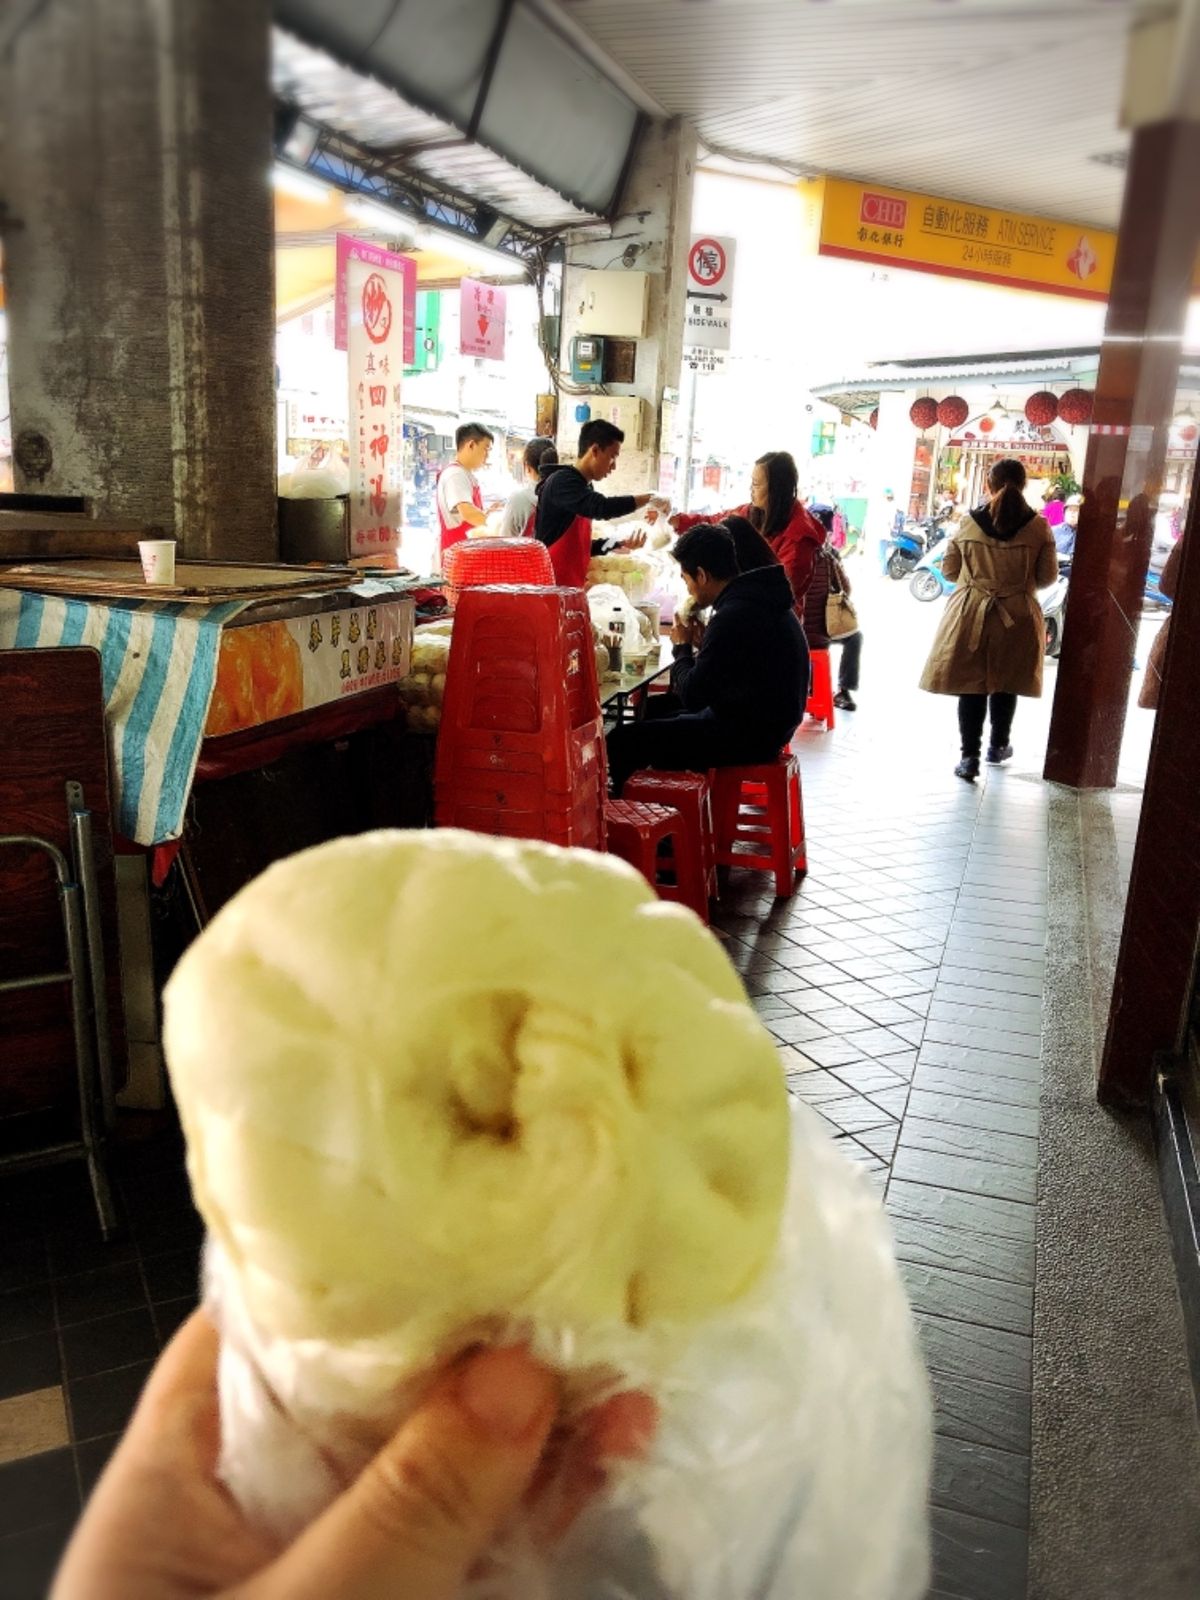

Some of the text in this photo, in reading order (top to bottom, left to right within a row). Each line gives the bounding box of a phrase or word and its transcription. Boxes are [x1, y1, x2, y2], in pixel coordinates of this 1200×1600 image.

[863, 197, 905, 227] CHB
[858, 226, 905, 248] 彰化銀行
[923, 203, 1057, 251] 自動化服務 ATM SERVICE
[695, 248, 719, 277] 停
[688, 317, 728, 329] SIDEWALK
